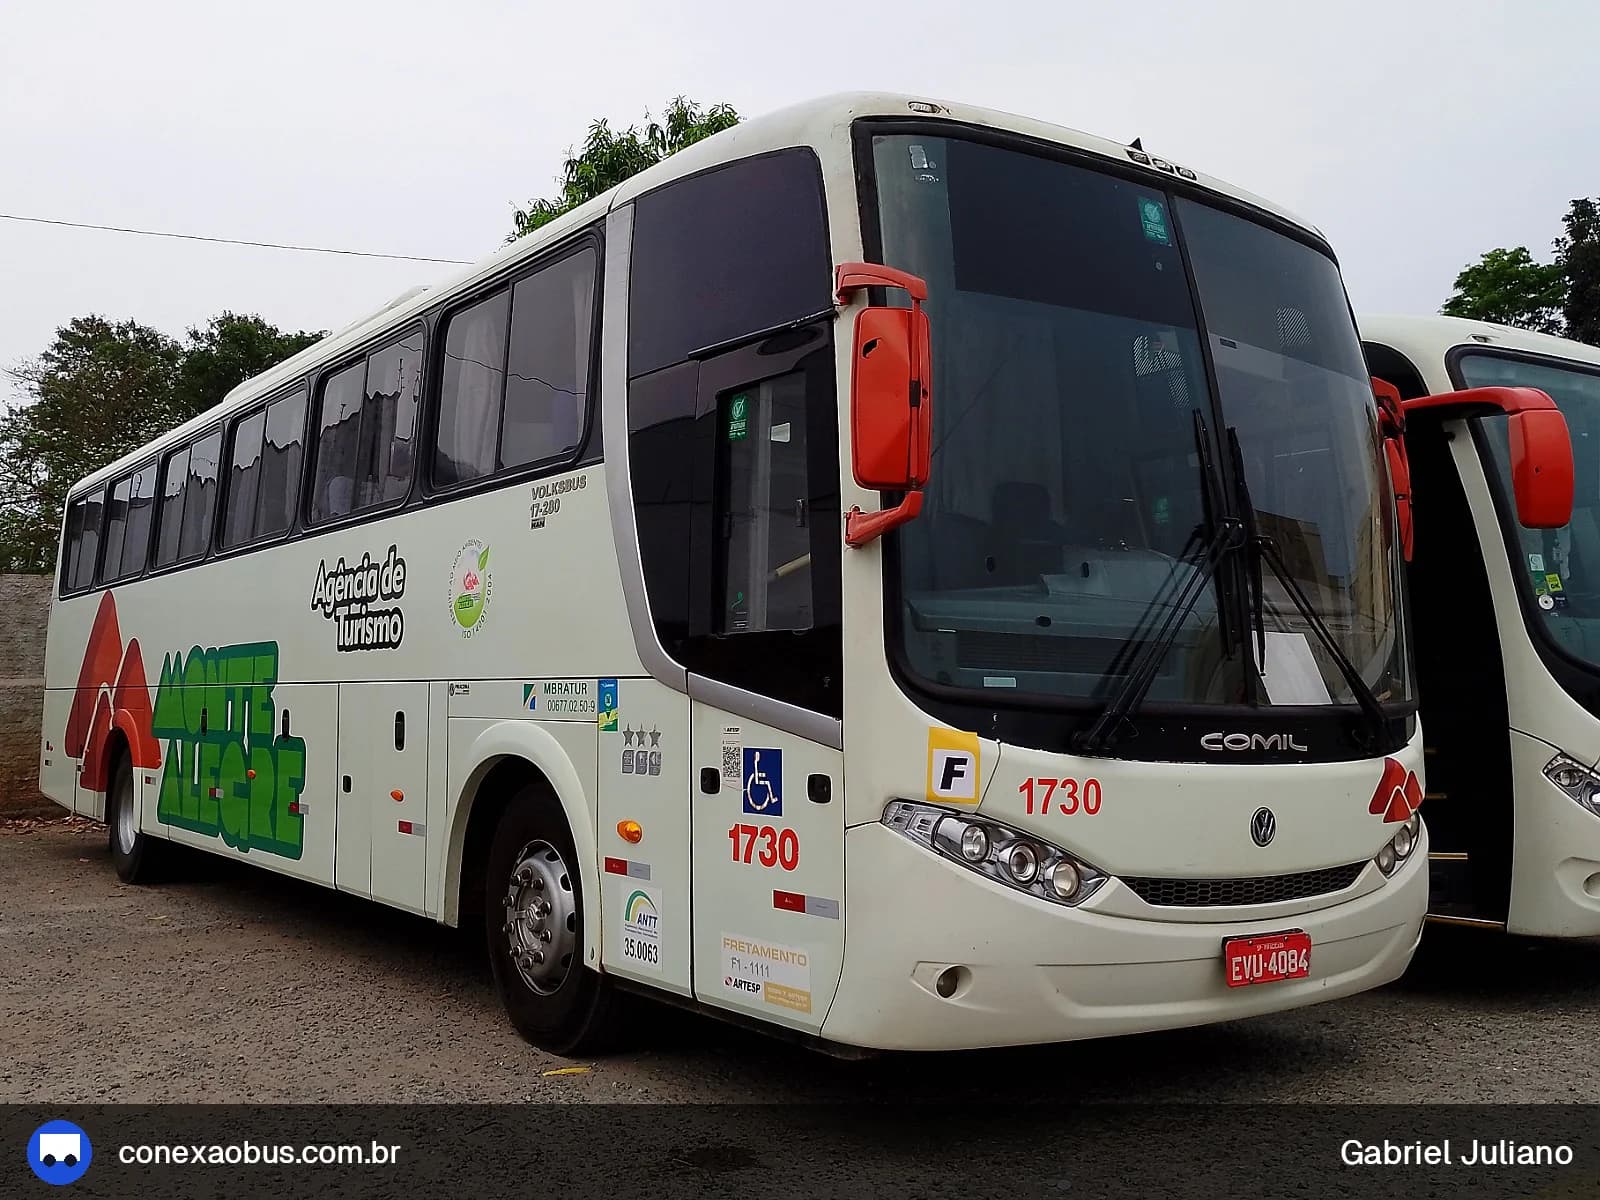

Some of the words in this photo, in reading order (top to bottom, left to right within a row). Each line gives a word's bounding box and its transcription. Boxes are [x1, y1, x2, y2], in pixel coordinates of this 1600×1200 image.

[531, 475, 587, 500] VOLKSBUS
[530, 498, 560, 518] 17-280
[312, 557, 378, 614] Agência
[381, 549, 405, 597] de
[335, 604, 402, 647] Turismo
[152, 641, 278, 738] MONTE
[543, 682, 588, 695] MBRATUR
[547, 699, 596, 713] 00677.02.50-9
[1200, 732, 1308, 752] COMIL
[940, 756, 969, 790] F
[157, 738, 306, 859] ALEGRE
[1018, 777, 1102, 816] 1730
[728, 823, 800, 872] 1730
[637, 912, 658, 929] ANTT
[624, 937, 658, 964] 35.0063
[723, 937, 807, 966] FRETAMENTO
[731, 957, 741, 970] F1
[750, 962, 770, 978] 1111
[733, 977, 761, 994] ARTESP
